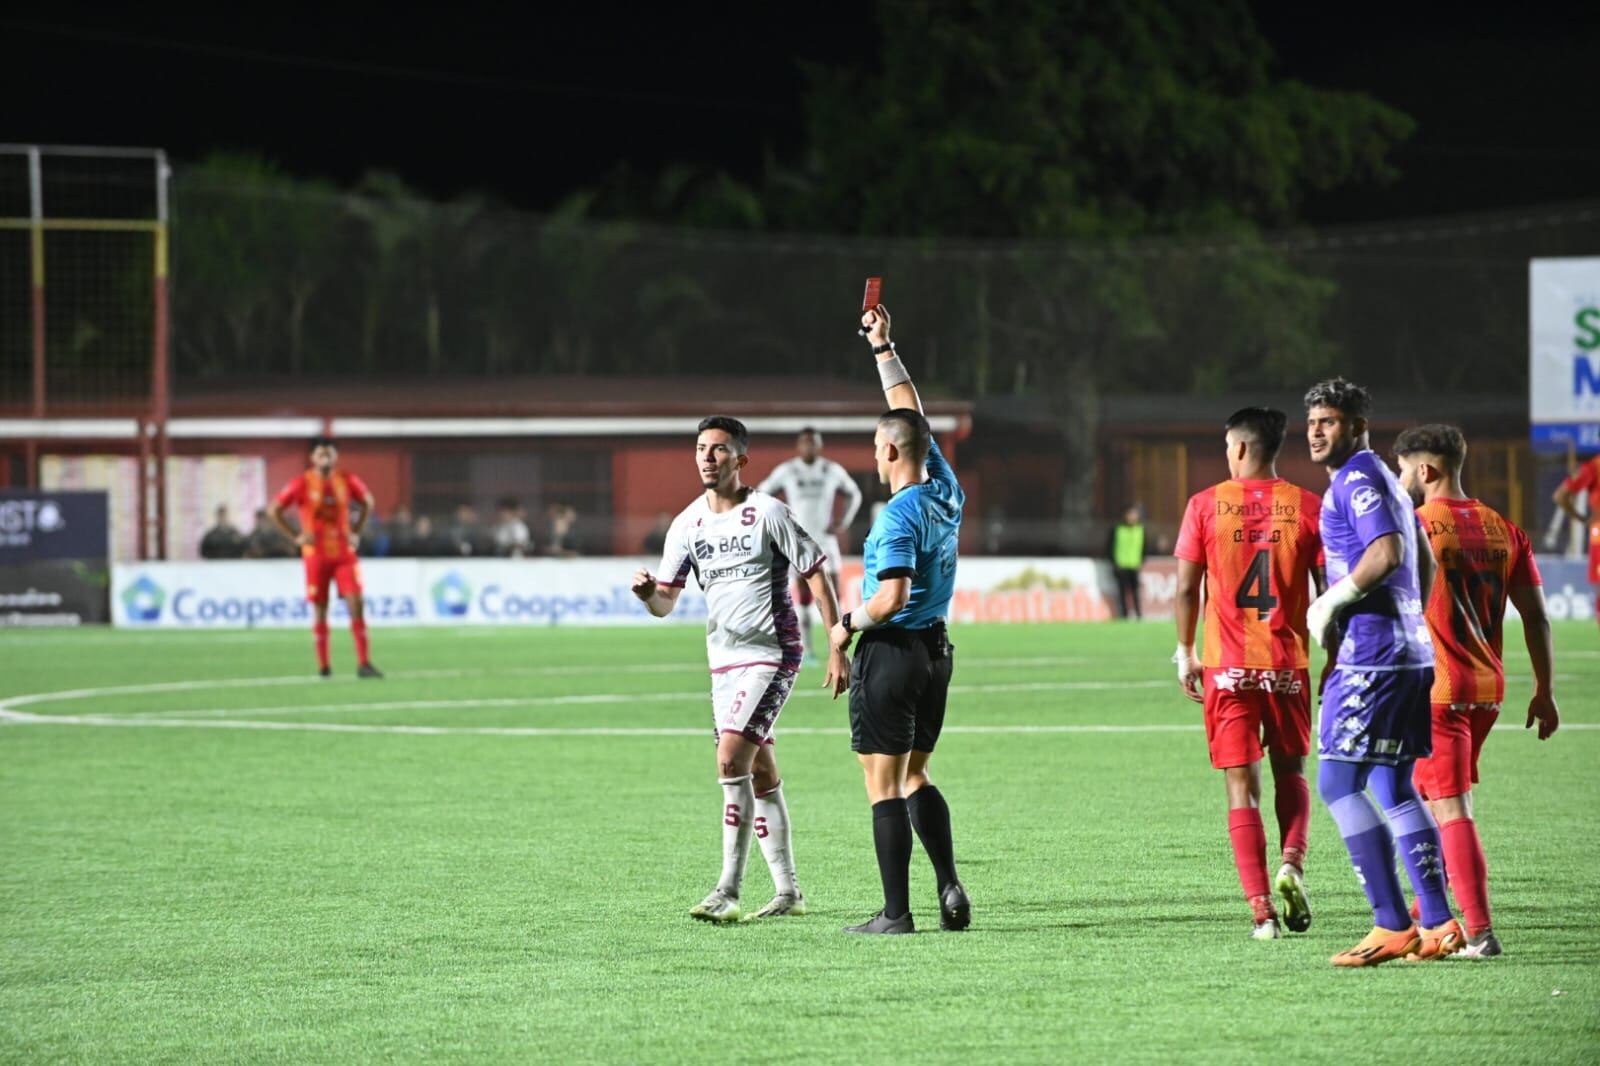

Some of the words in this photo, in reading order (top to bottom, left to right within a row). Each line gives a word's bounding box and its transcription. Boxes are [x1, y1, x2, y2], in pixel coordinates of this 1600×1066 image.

[740, 506, 757, 527] S
[719, 534, 752, 553] BAC
[1235, 548, 1279, 621] 4
[172, 587, 417, 627] Coopeaanza
[724, 803, 741, 827] S
[754, 816, 769, 839] S
